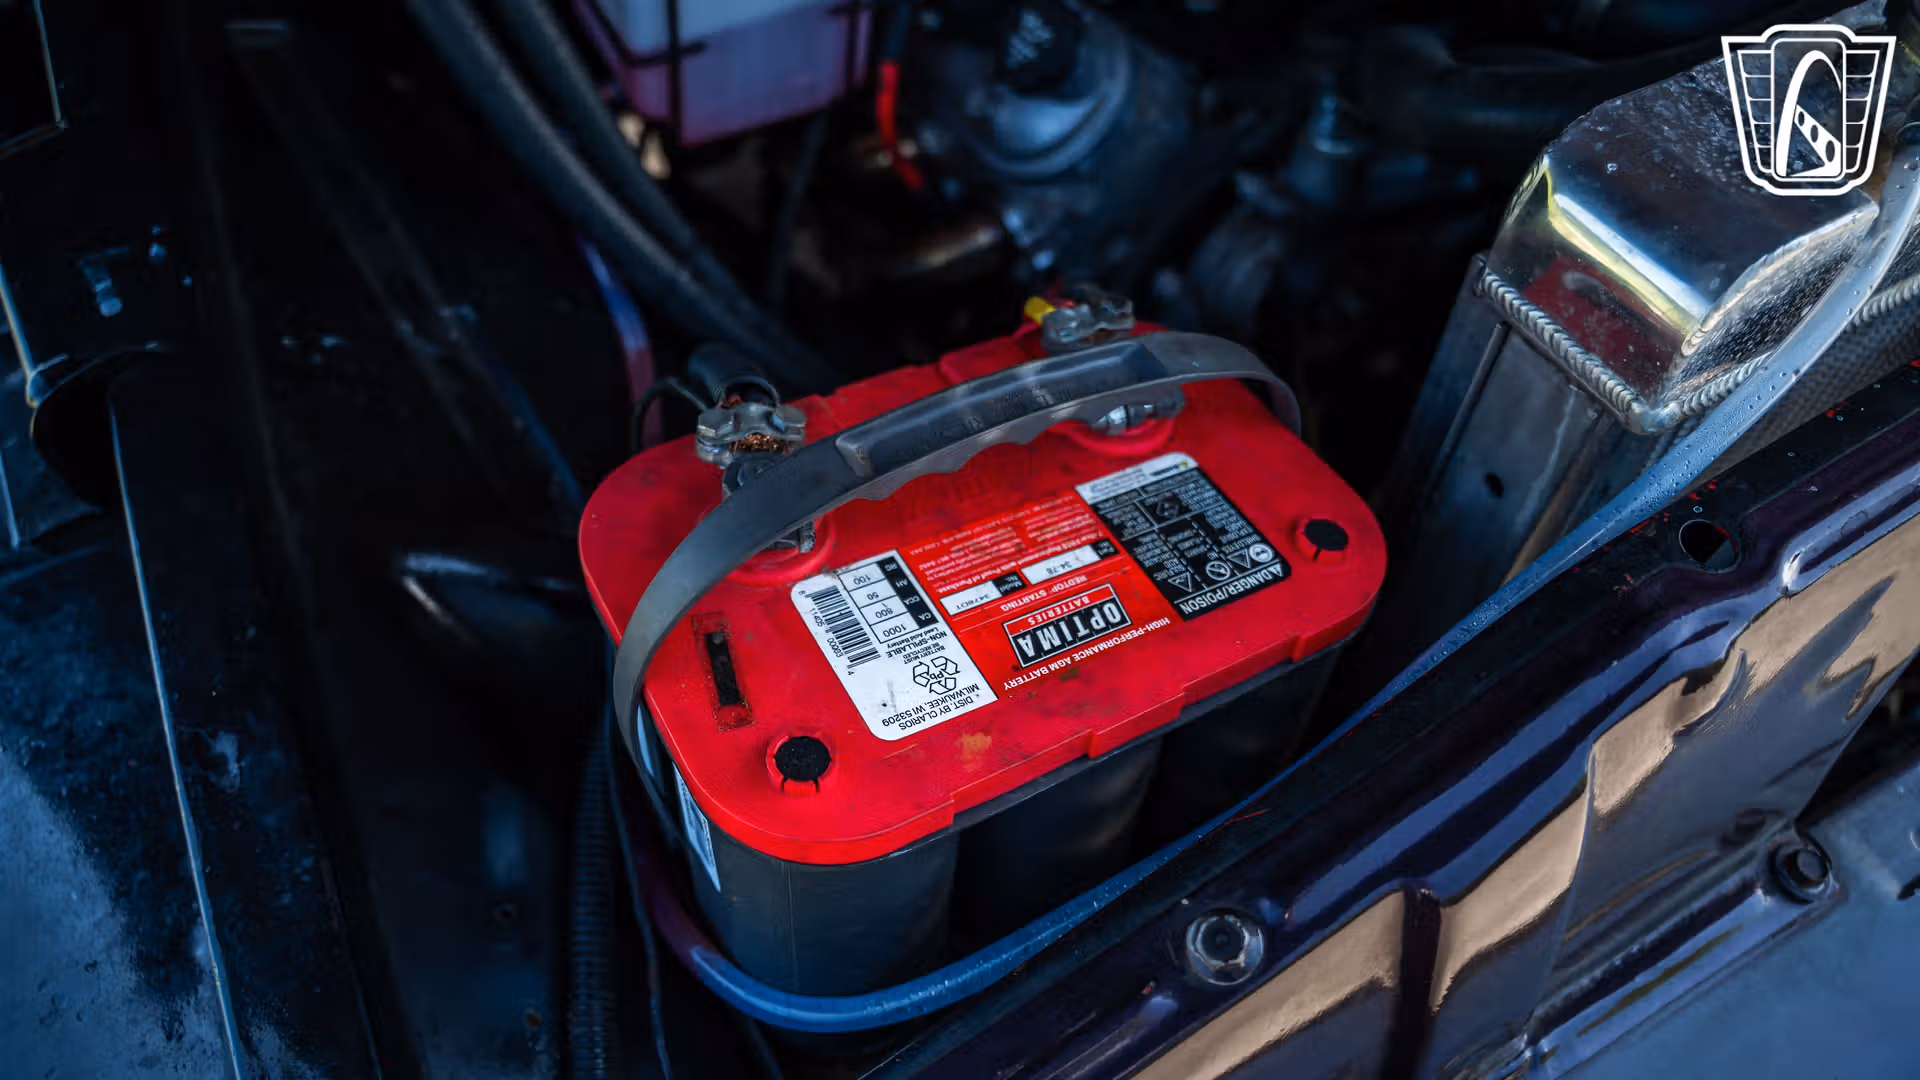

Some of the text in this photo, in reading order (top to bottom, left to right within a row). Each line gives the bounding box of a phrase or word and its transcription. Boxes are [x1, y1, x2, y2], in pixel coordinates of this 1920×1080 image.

[979, 567, 1001, 579] Proof
[1162, 557, 1180, 568] ACID
[852, 573, 871, 585] 100
[865, 578, 909, 600] AH 50
[971, 574, 981, 582] of
[998, 579, 1022, 593] Model
[999, 573, 1087, 612] REDTOP STARTING
[1178, 569, 1273, 614] DANGER/POISON
[808, 607, 825, 627] 11405
[873, 595, 920, 619] CCA 800
[1025, 595, 1090, 625] BATTERIES
[881, 611, 932, 637] CA 1000
[1015, 601, 1125, 658] OPTIMA
[885, 626, 938, 649] Lead Acid Battery
[885, 630, 947, 658] NON-SPILLABLE
[902, 645, 931, 659] RECYCLED
[902, 645, 944, 664] BATTERY MUST
[1000, 616, 1170, 690] HIGH-PERFORMANCE AGM BATTERY
[928, 670, 944, 681] Pb
[881, 682, 979, 727] MILWAUKEE, WI 53209
[897, 695, 973, 730] DIST. BY CLARIOS
